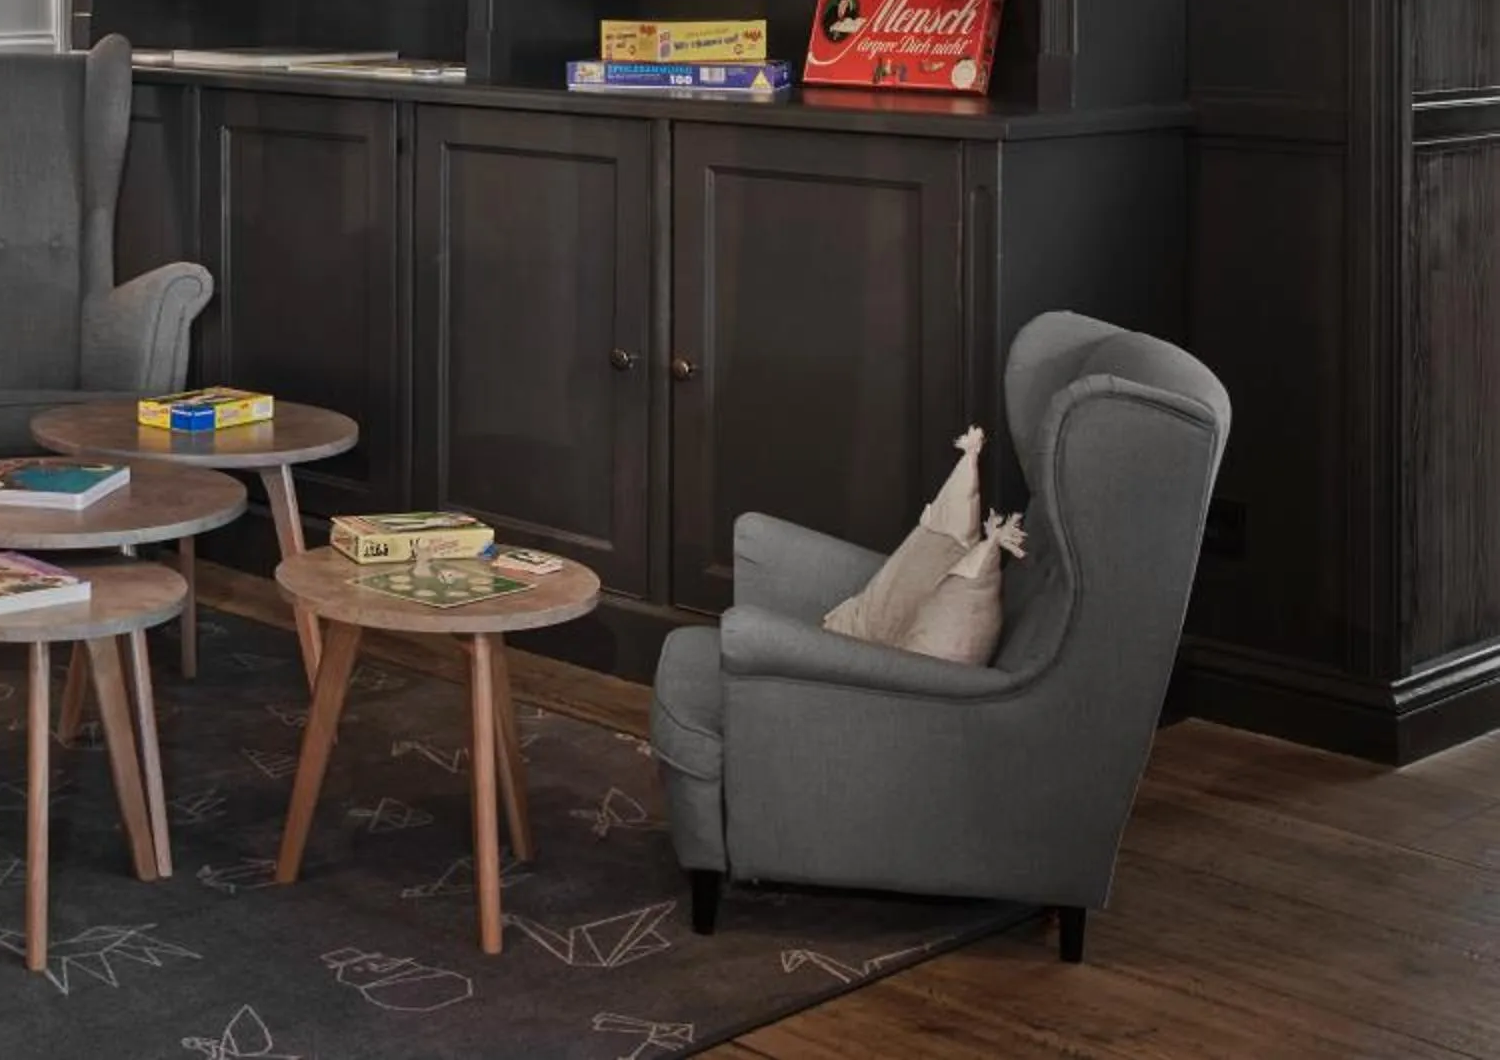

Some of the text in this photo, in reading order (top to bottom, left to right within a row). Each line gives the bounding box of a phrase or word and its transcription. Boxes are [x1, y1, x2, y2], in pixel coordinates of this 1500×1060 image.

[897, 36, 931, 56] Dich
[931, 37, 967, 56] nicht
[669, 74, 693, 85] 100
